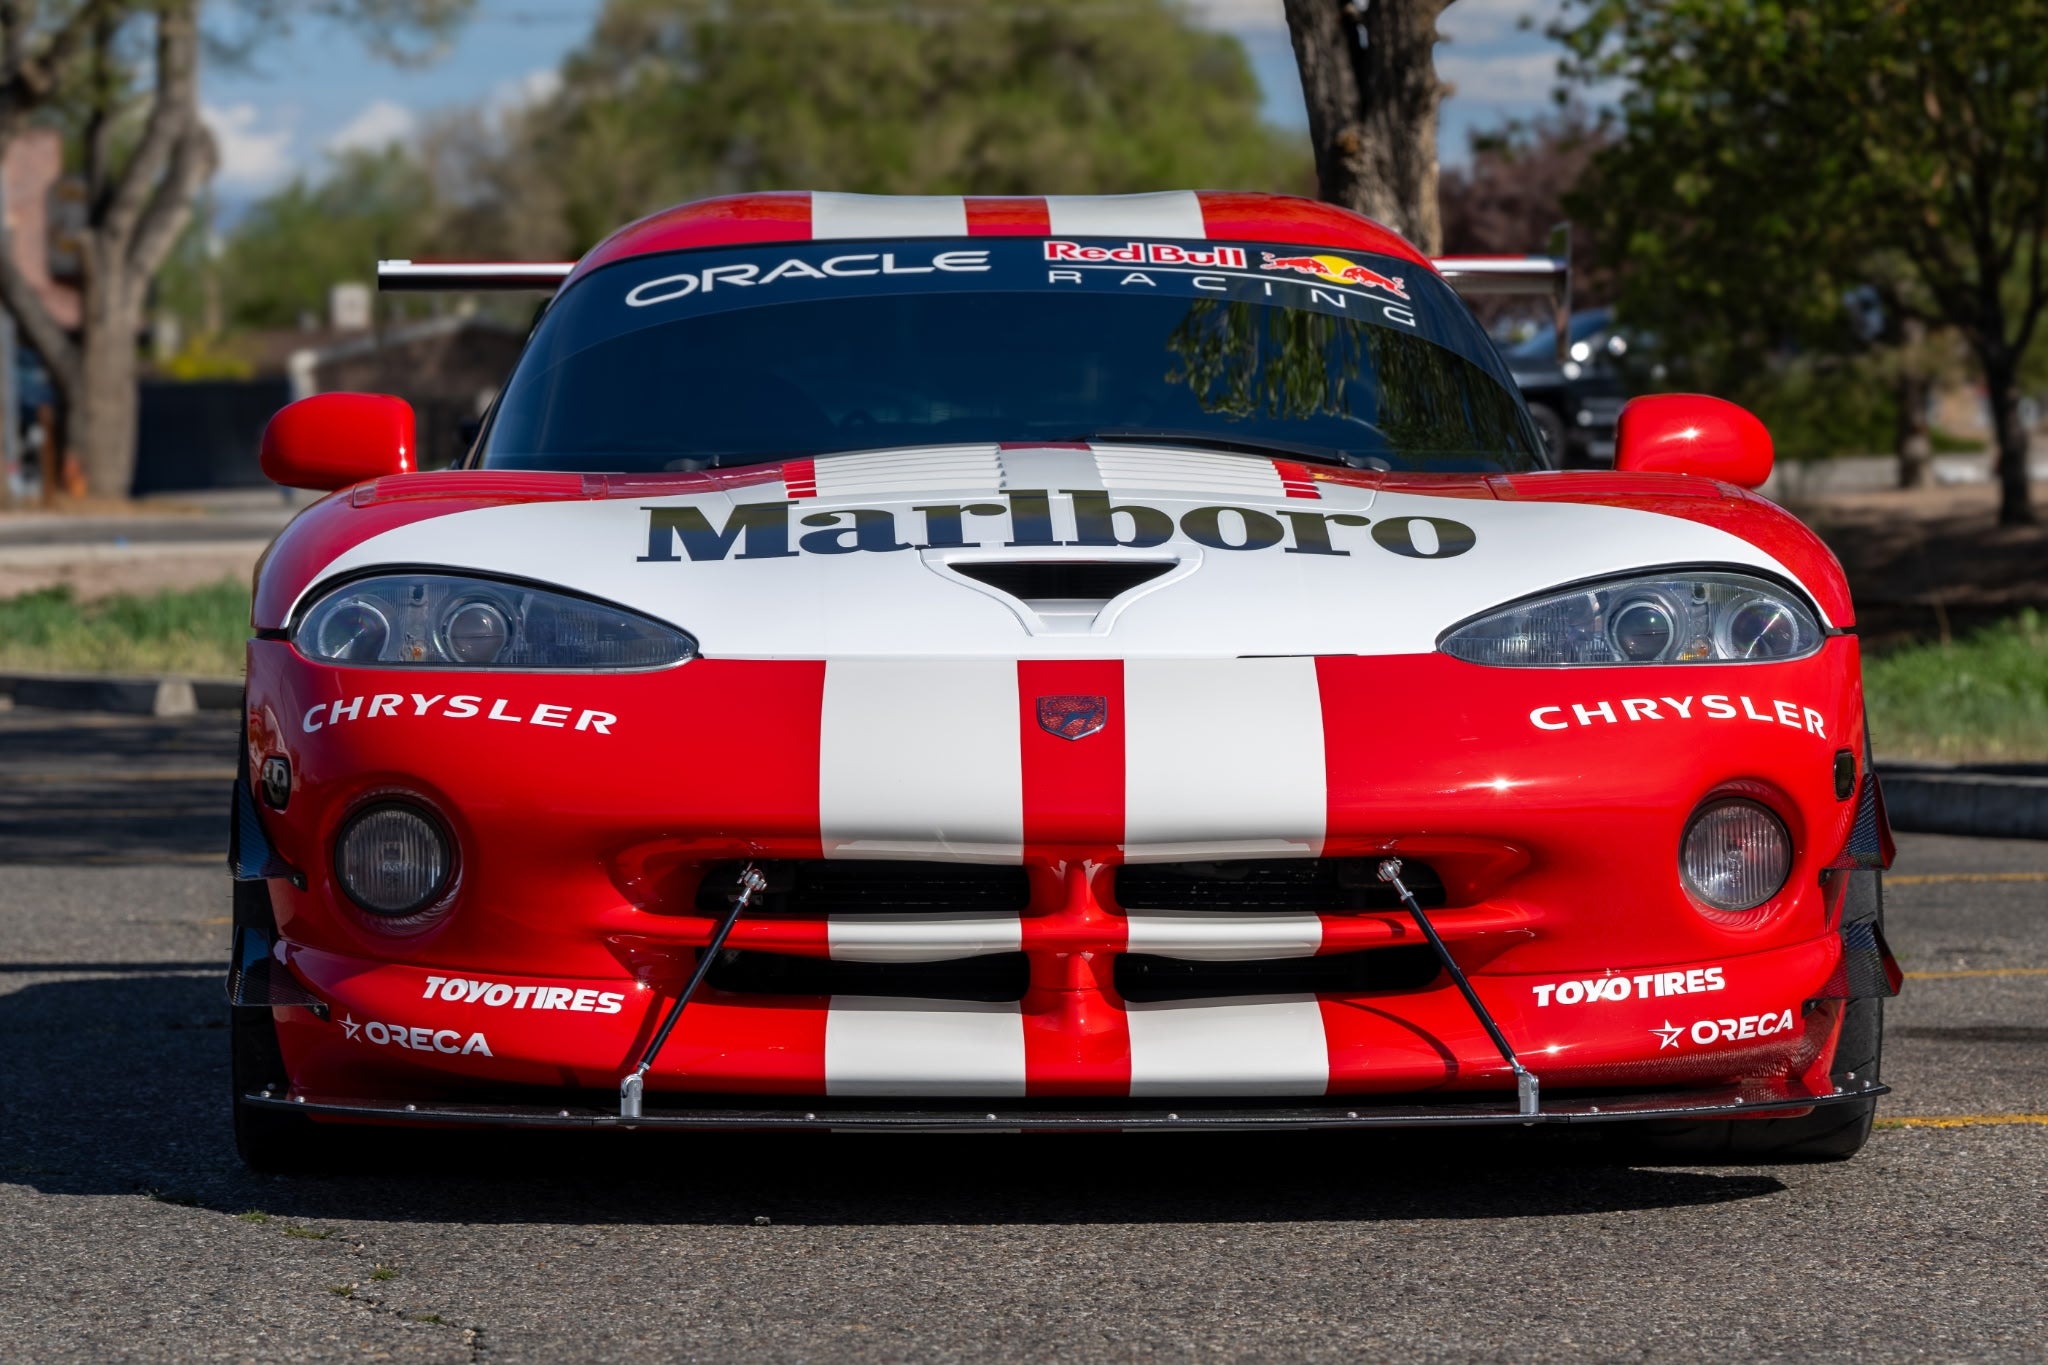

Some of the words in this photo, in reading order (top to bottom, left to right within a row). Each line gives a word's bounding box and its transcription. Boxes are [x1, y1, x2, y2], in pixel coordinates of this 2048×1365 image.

[1044, 241, 1144, 263] Red
[1148, 243, 1247, 270] Bull
[625, 251, 992, 308] ORACLE
[1048, 270, 1416, 327] RACING
[635, 489, 1477, 563] Marlboro
[302, 693, 617, 735] CHRYSLER
[1529, 694, 1827, 740] CHRYSLER
[365, 1021, 494, 1057] ORECA
[1691, 1008, 1794, 1045] ORECA
